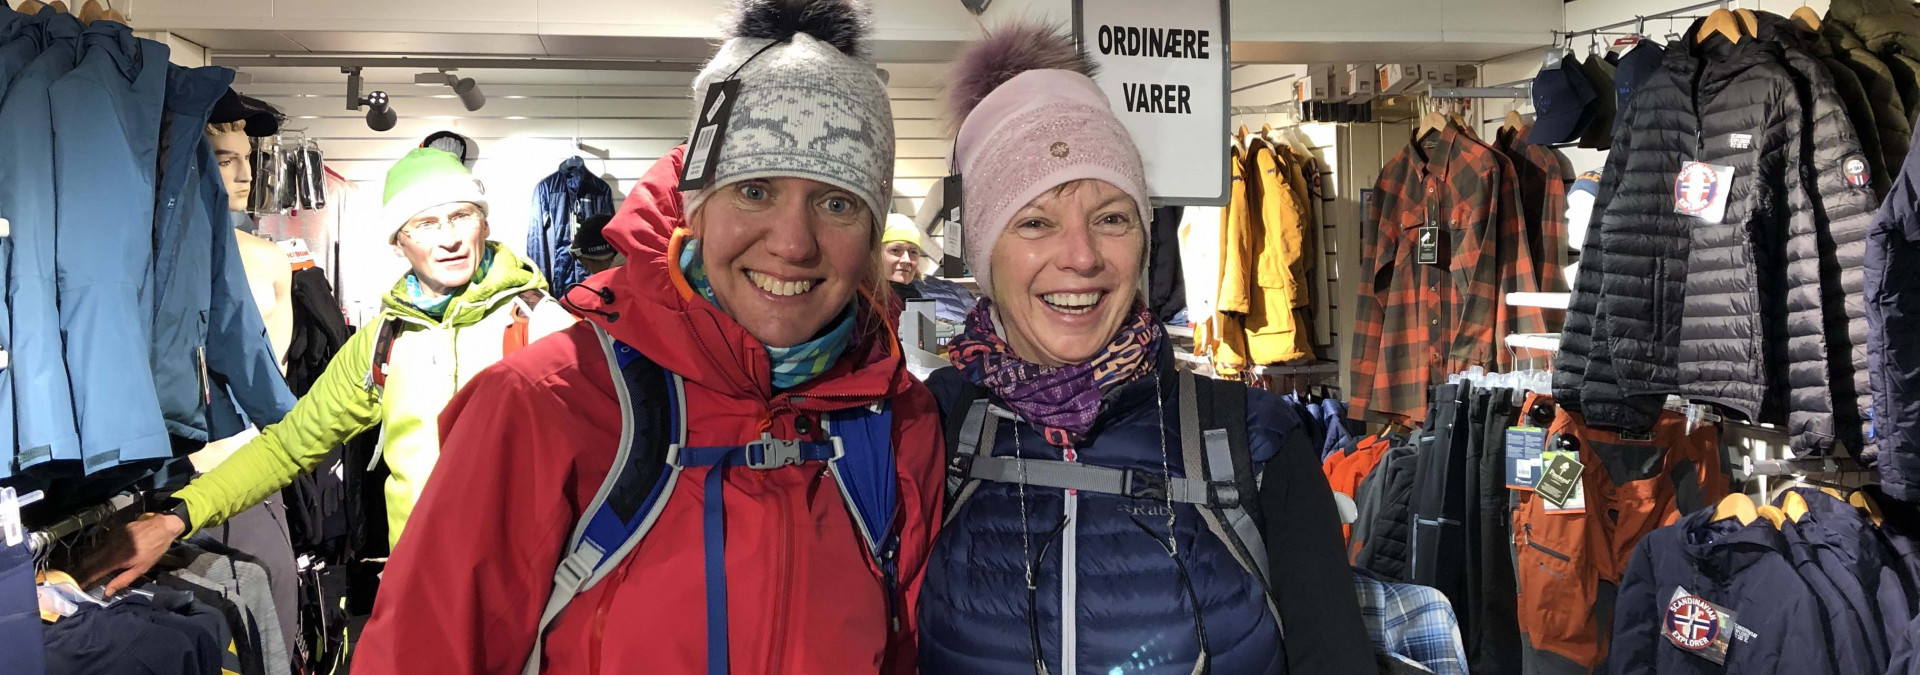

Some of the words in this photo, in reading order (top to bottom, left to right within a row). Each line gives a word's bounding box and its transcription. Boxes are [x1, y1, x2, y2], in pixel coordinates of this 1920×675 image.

[1098, 24, 1210, 59] ORDINÆRE
[1122, 82, 1192, 114] VARER
[1669, 597, 1717, 621] SCANDINAVIAN
[1671, 630, 1710, 648] EXPLORER
